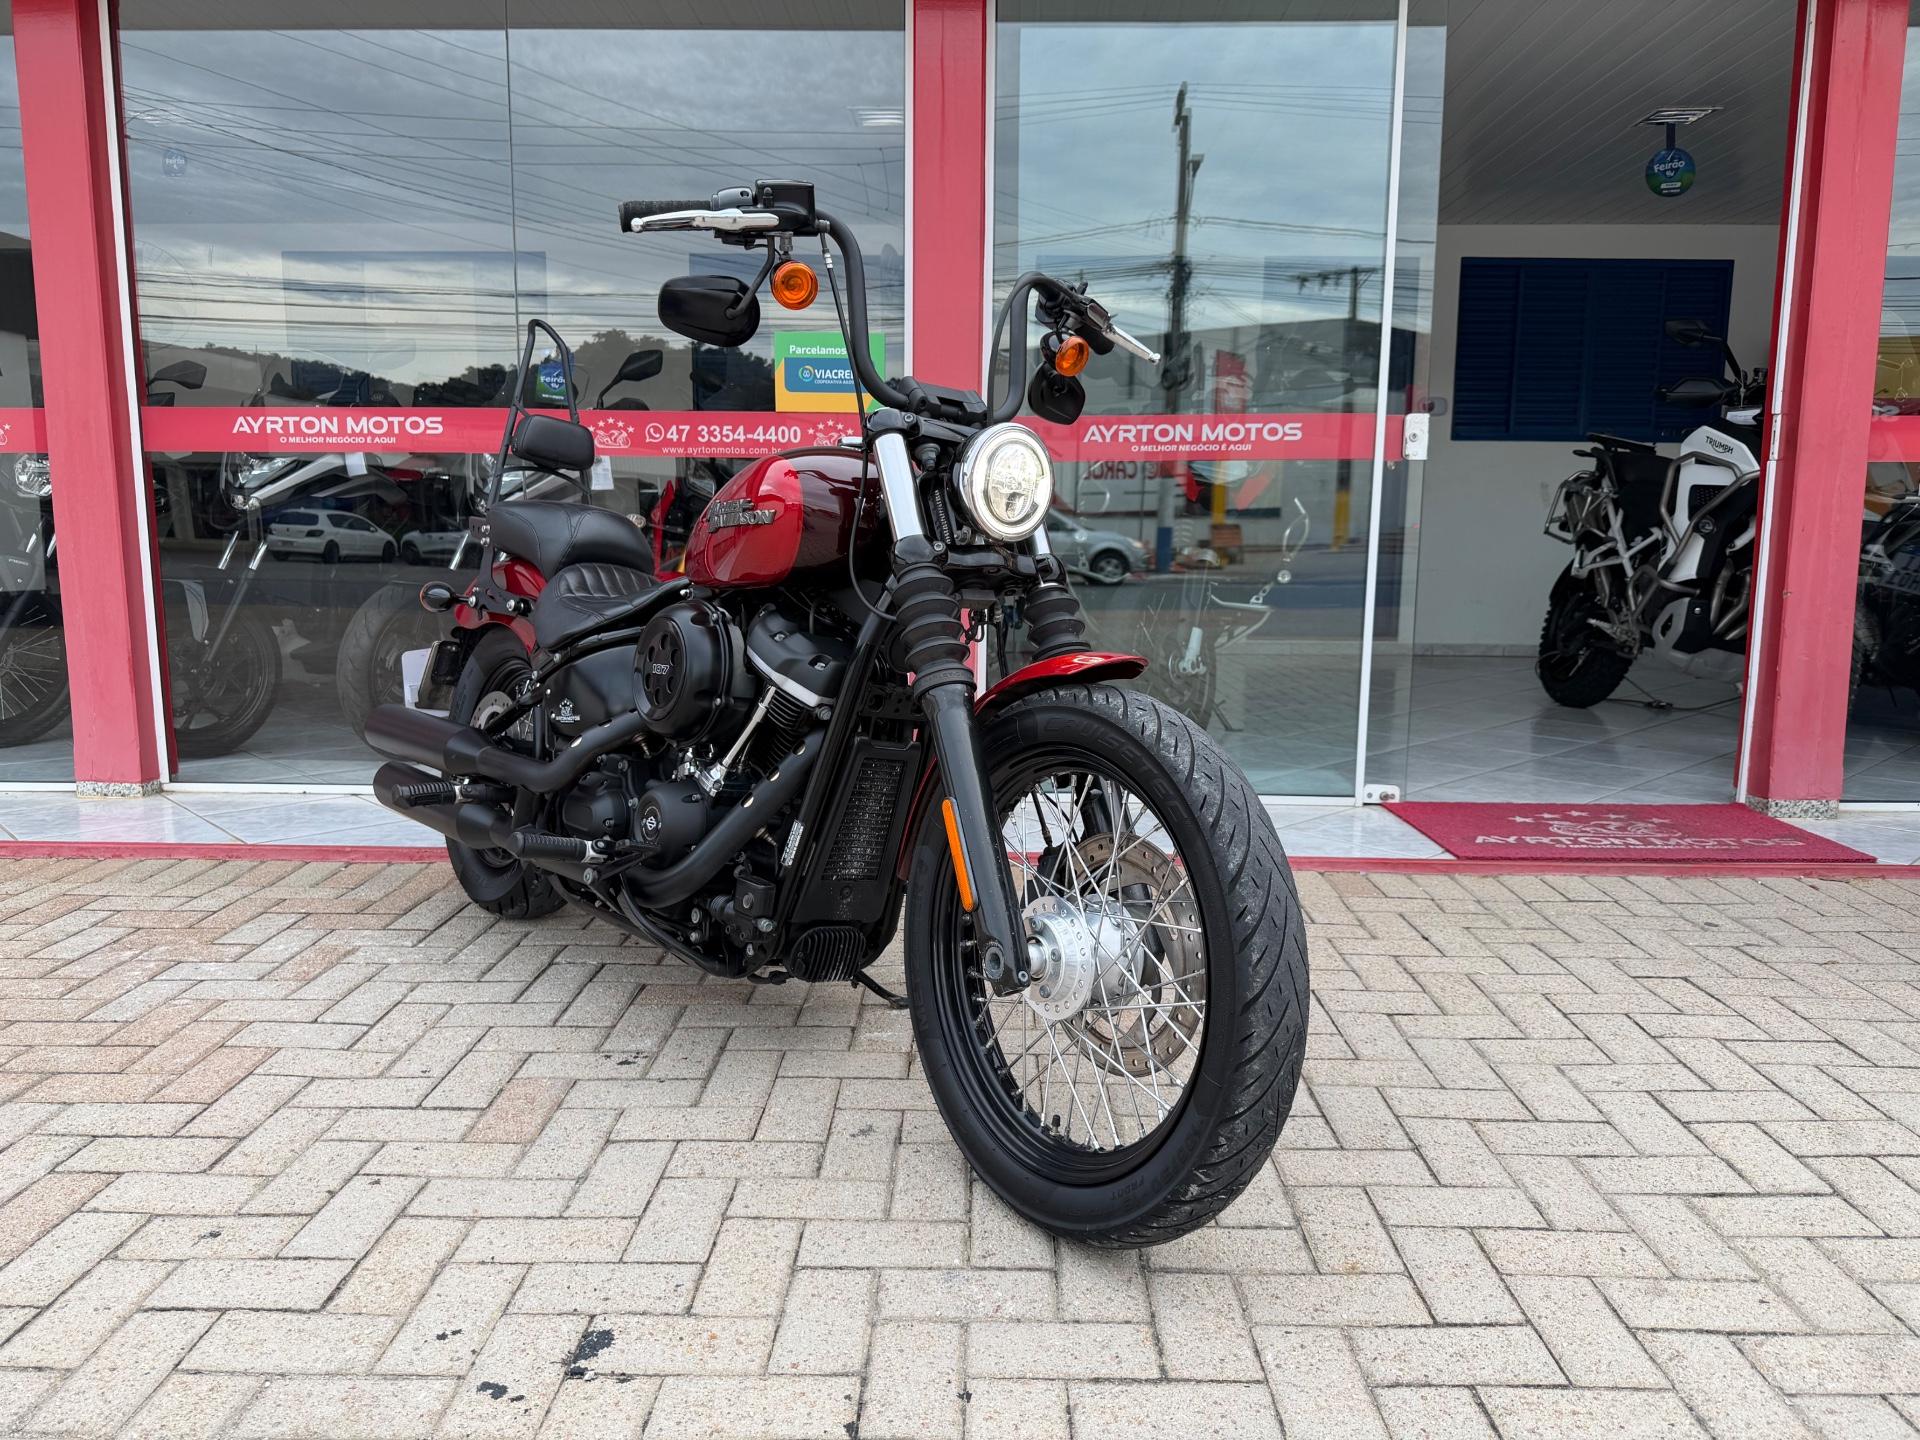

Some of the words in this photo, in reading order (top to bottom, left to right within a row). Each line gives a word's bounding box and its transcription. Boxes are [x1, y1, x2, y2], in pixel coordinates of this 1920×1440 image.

[1653, 160, 1686, 173] Feirão
[789, 345, 847, 355] Parcelamos
[232, 416, 339, 434] AYRTON
[346, 416, 444, 434] MOTOS
[666, 425, 691, 443] 47
[697, 425, 801, 443] 3354-4400
[1083, 424, 1193, 443] AYRTON
[1202, 422, 1303, 442] MOTOS
[280, 436, 287, 444] O
[288, 436, 324, 444] MELHOR
[326, 434, 365, 444] NEGÓCIO
[366, 434, 373, 444] É
[374, 436, 396, 444] AQUI
[1140, 444, 1177, 452] MELHOR
[1179, 443, 1219, 452] NEGÓCIO
[1220, 443, 1227, 452] É
[1228, 443, 1252, 452] AQUI
[1705, 435, 1734, 455] TRIUMPH
[661, 446, 781, 456] www.ayrtonmotos.com.br
[1475, 836, 1645, 845] AYRTON
[1648, 837, 1806, 846] MOTOS
